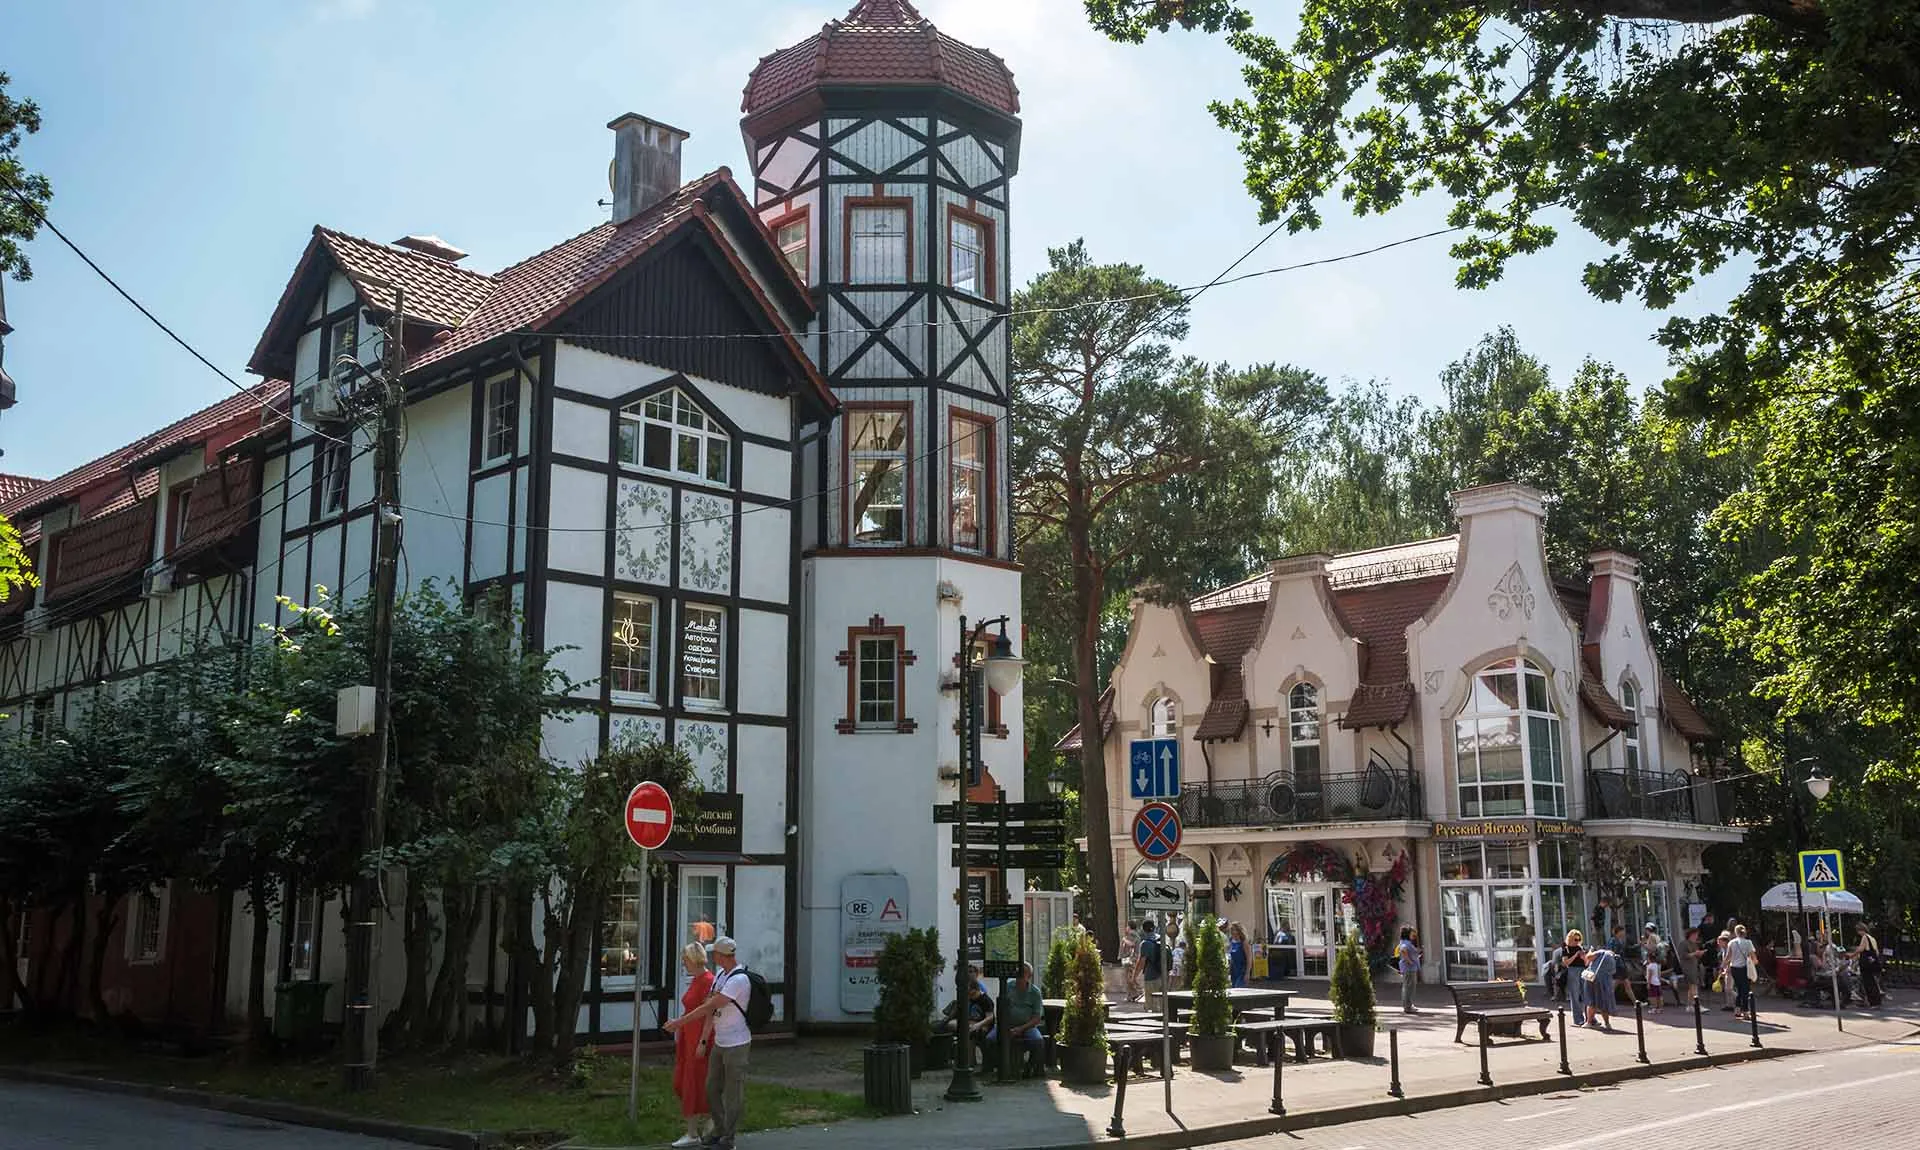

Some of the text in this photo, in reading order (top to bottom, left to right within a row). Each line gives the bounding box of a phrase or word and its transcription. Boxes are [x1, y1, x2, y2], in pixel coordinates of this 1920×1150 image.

[1435, 822, 1528, 838] Русский Янтарь
[853, 903, 868, 914] RE
[968, 900, 980, 911] RE
